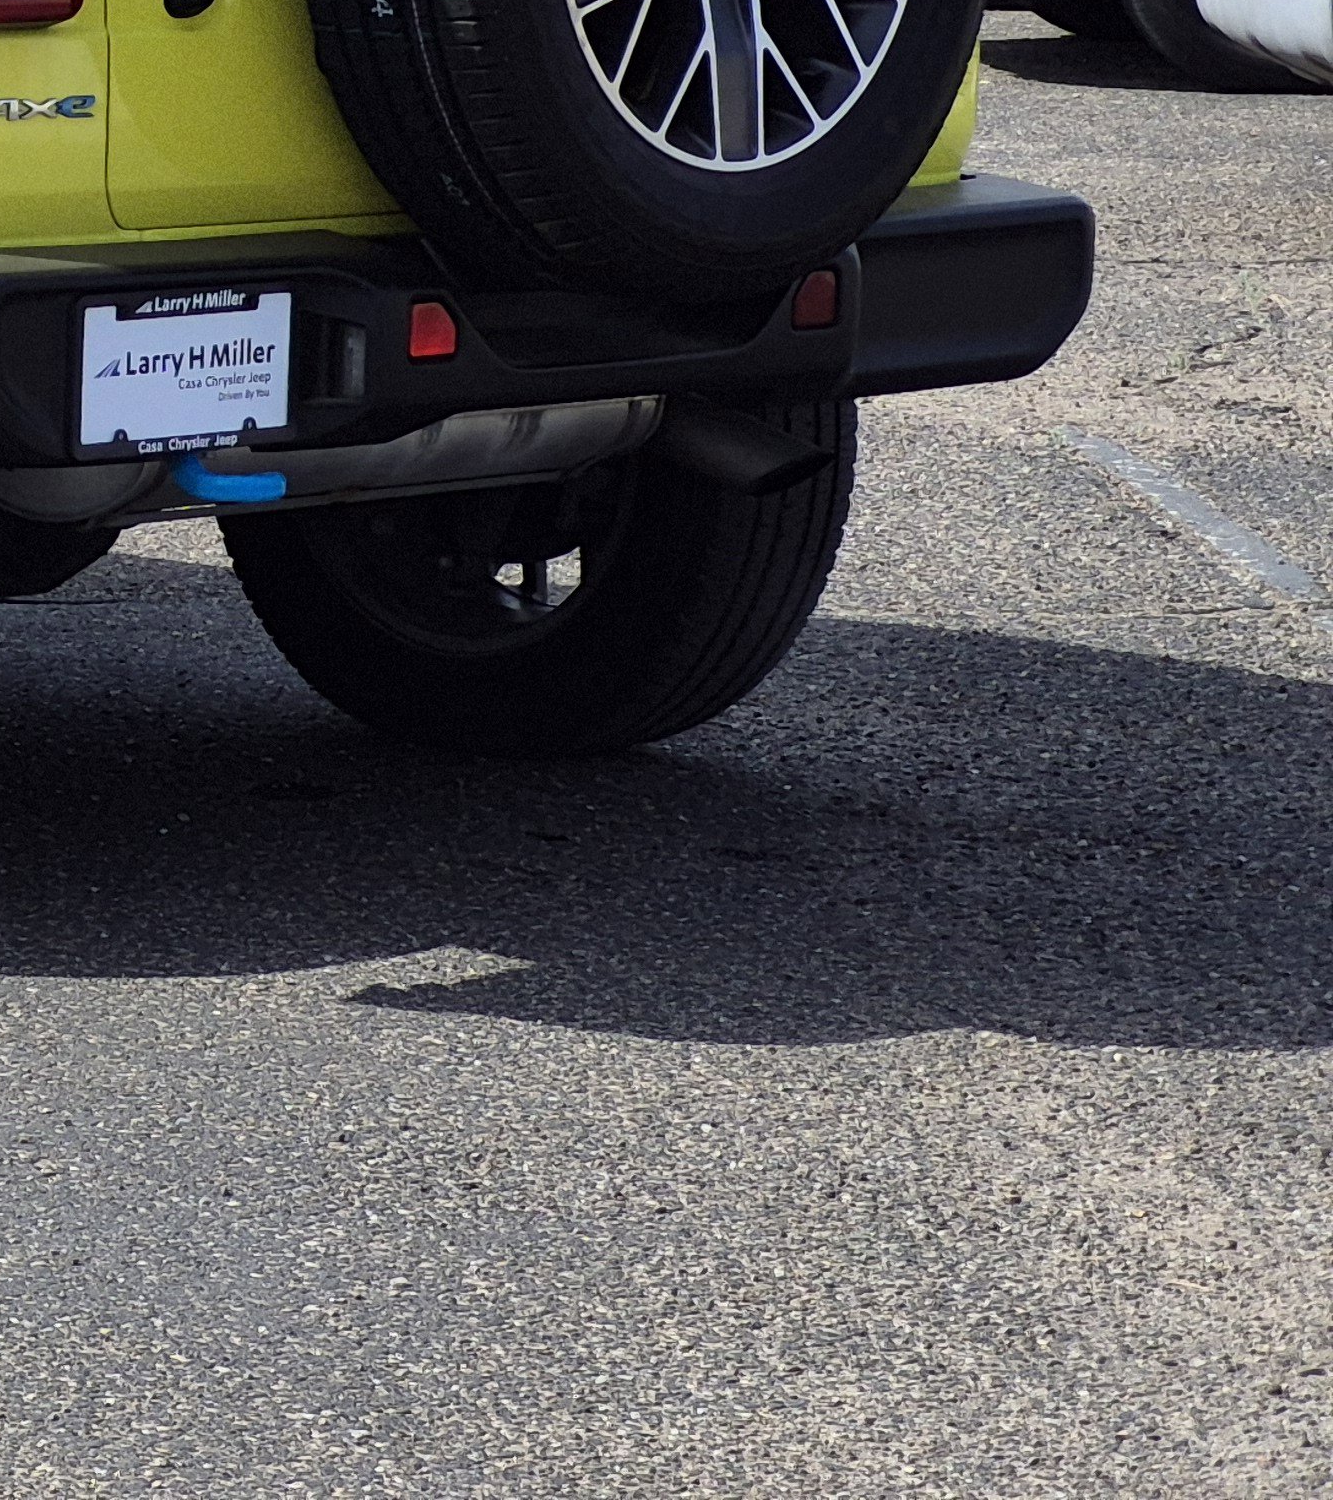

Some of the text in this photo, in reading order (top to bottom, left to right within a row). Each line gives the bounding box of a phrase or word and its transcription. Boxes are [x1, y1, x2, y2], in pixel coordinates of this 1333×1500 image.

[154, 289, 247, 314] Larry H Miller
[126, 338, 276, 378] Larry H Miller
[178, 371, 272, 390] Casa Chrysler Jeep
[245, 389, 255, 399] By
[256, 388, 270, 398] You
[137, 433, 238, 455] Casa Chrysler Jeep
